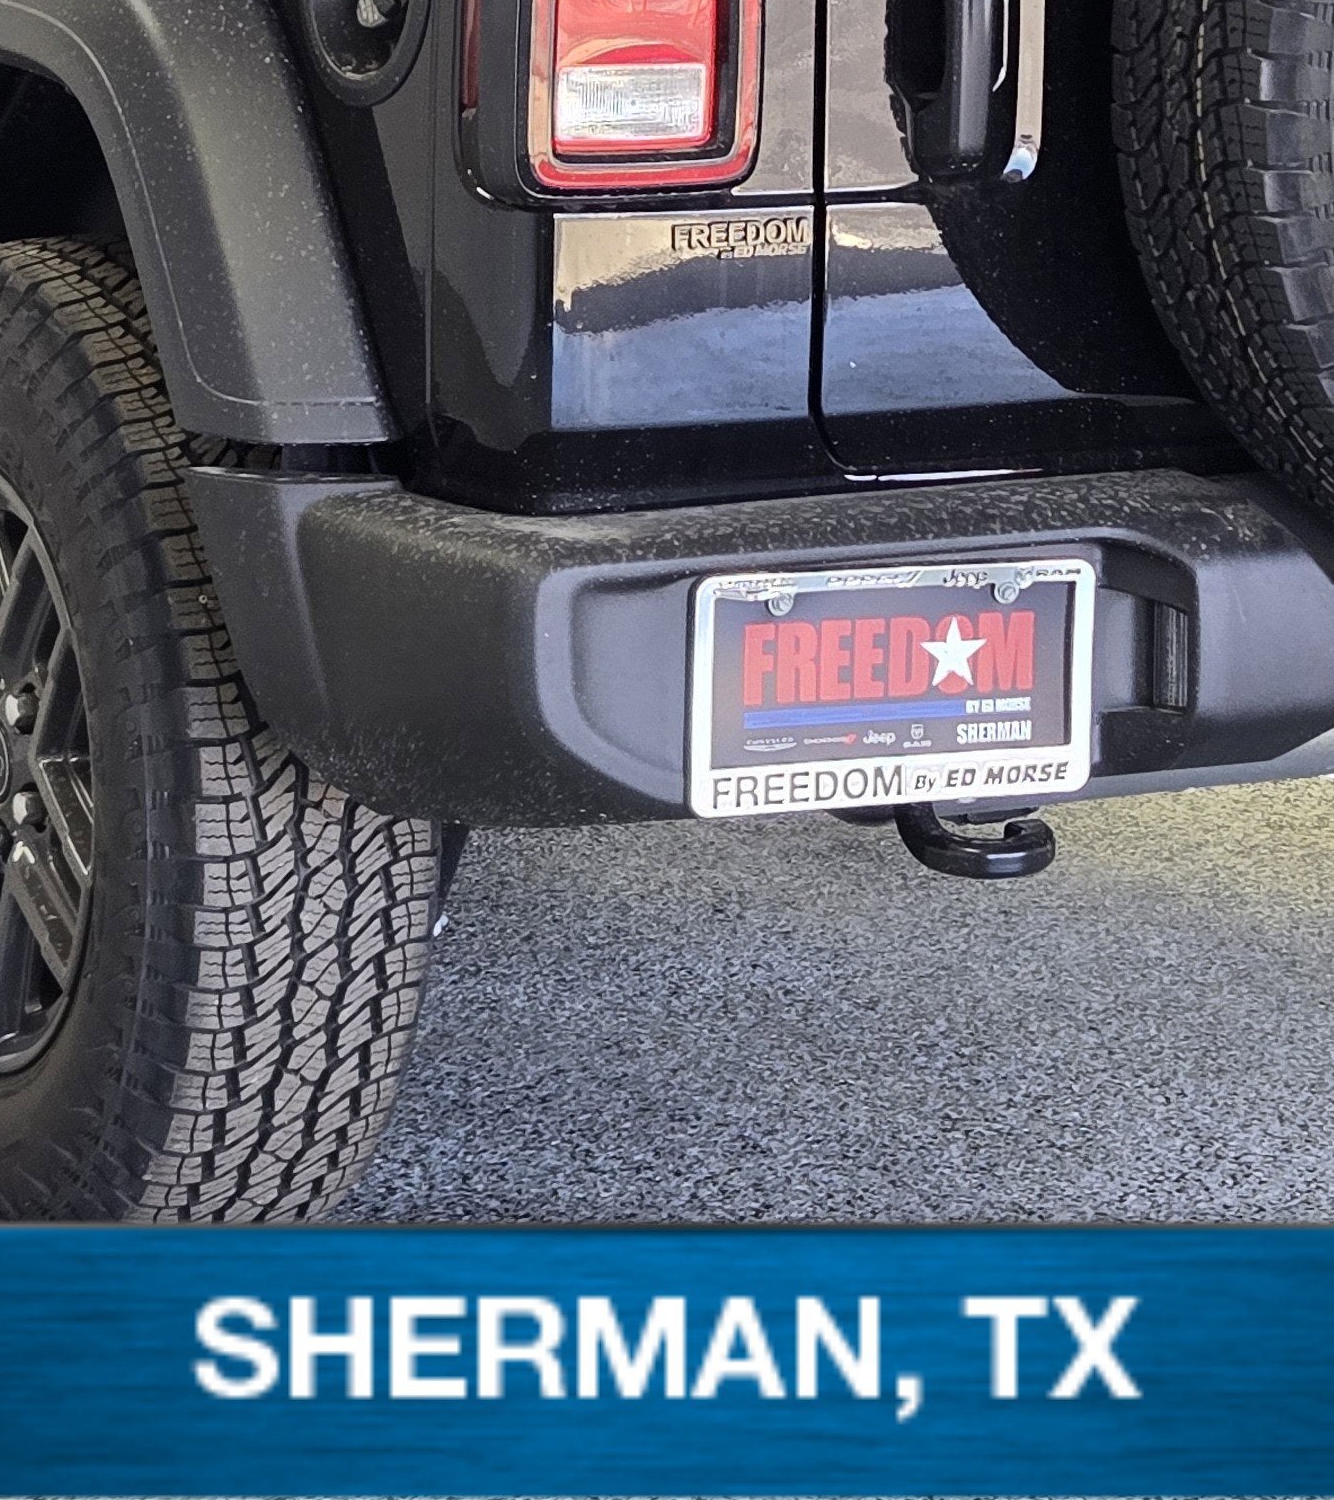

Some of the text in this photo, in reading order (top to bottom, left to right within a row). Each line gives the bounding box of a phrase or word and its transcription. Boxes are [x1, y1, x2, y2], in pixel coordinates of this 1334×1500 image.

[672, 217, 811, 250] FREEDOM
[743, 611, 1034, 705] FREEDOM
[956, 719, 1032, 745] SHERMAN
[712, 761, 1069, 809] FREEDOM By ED MORSE
